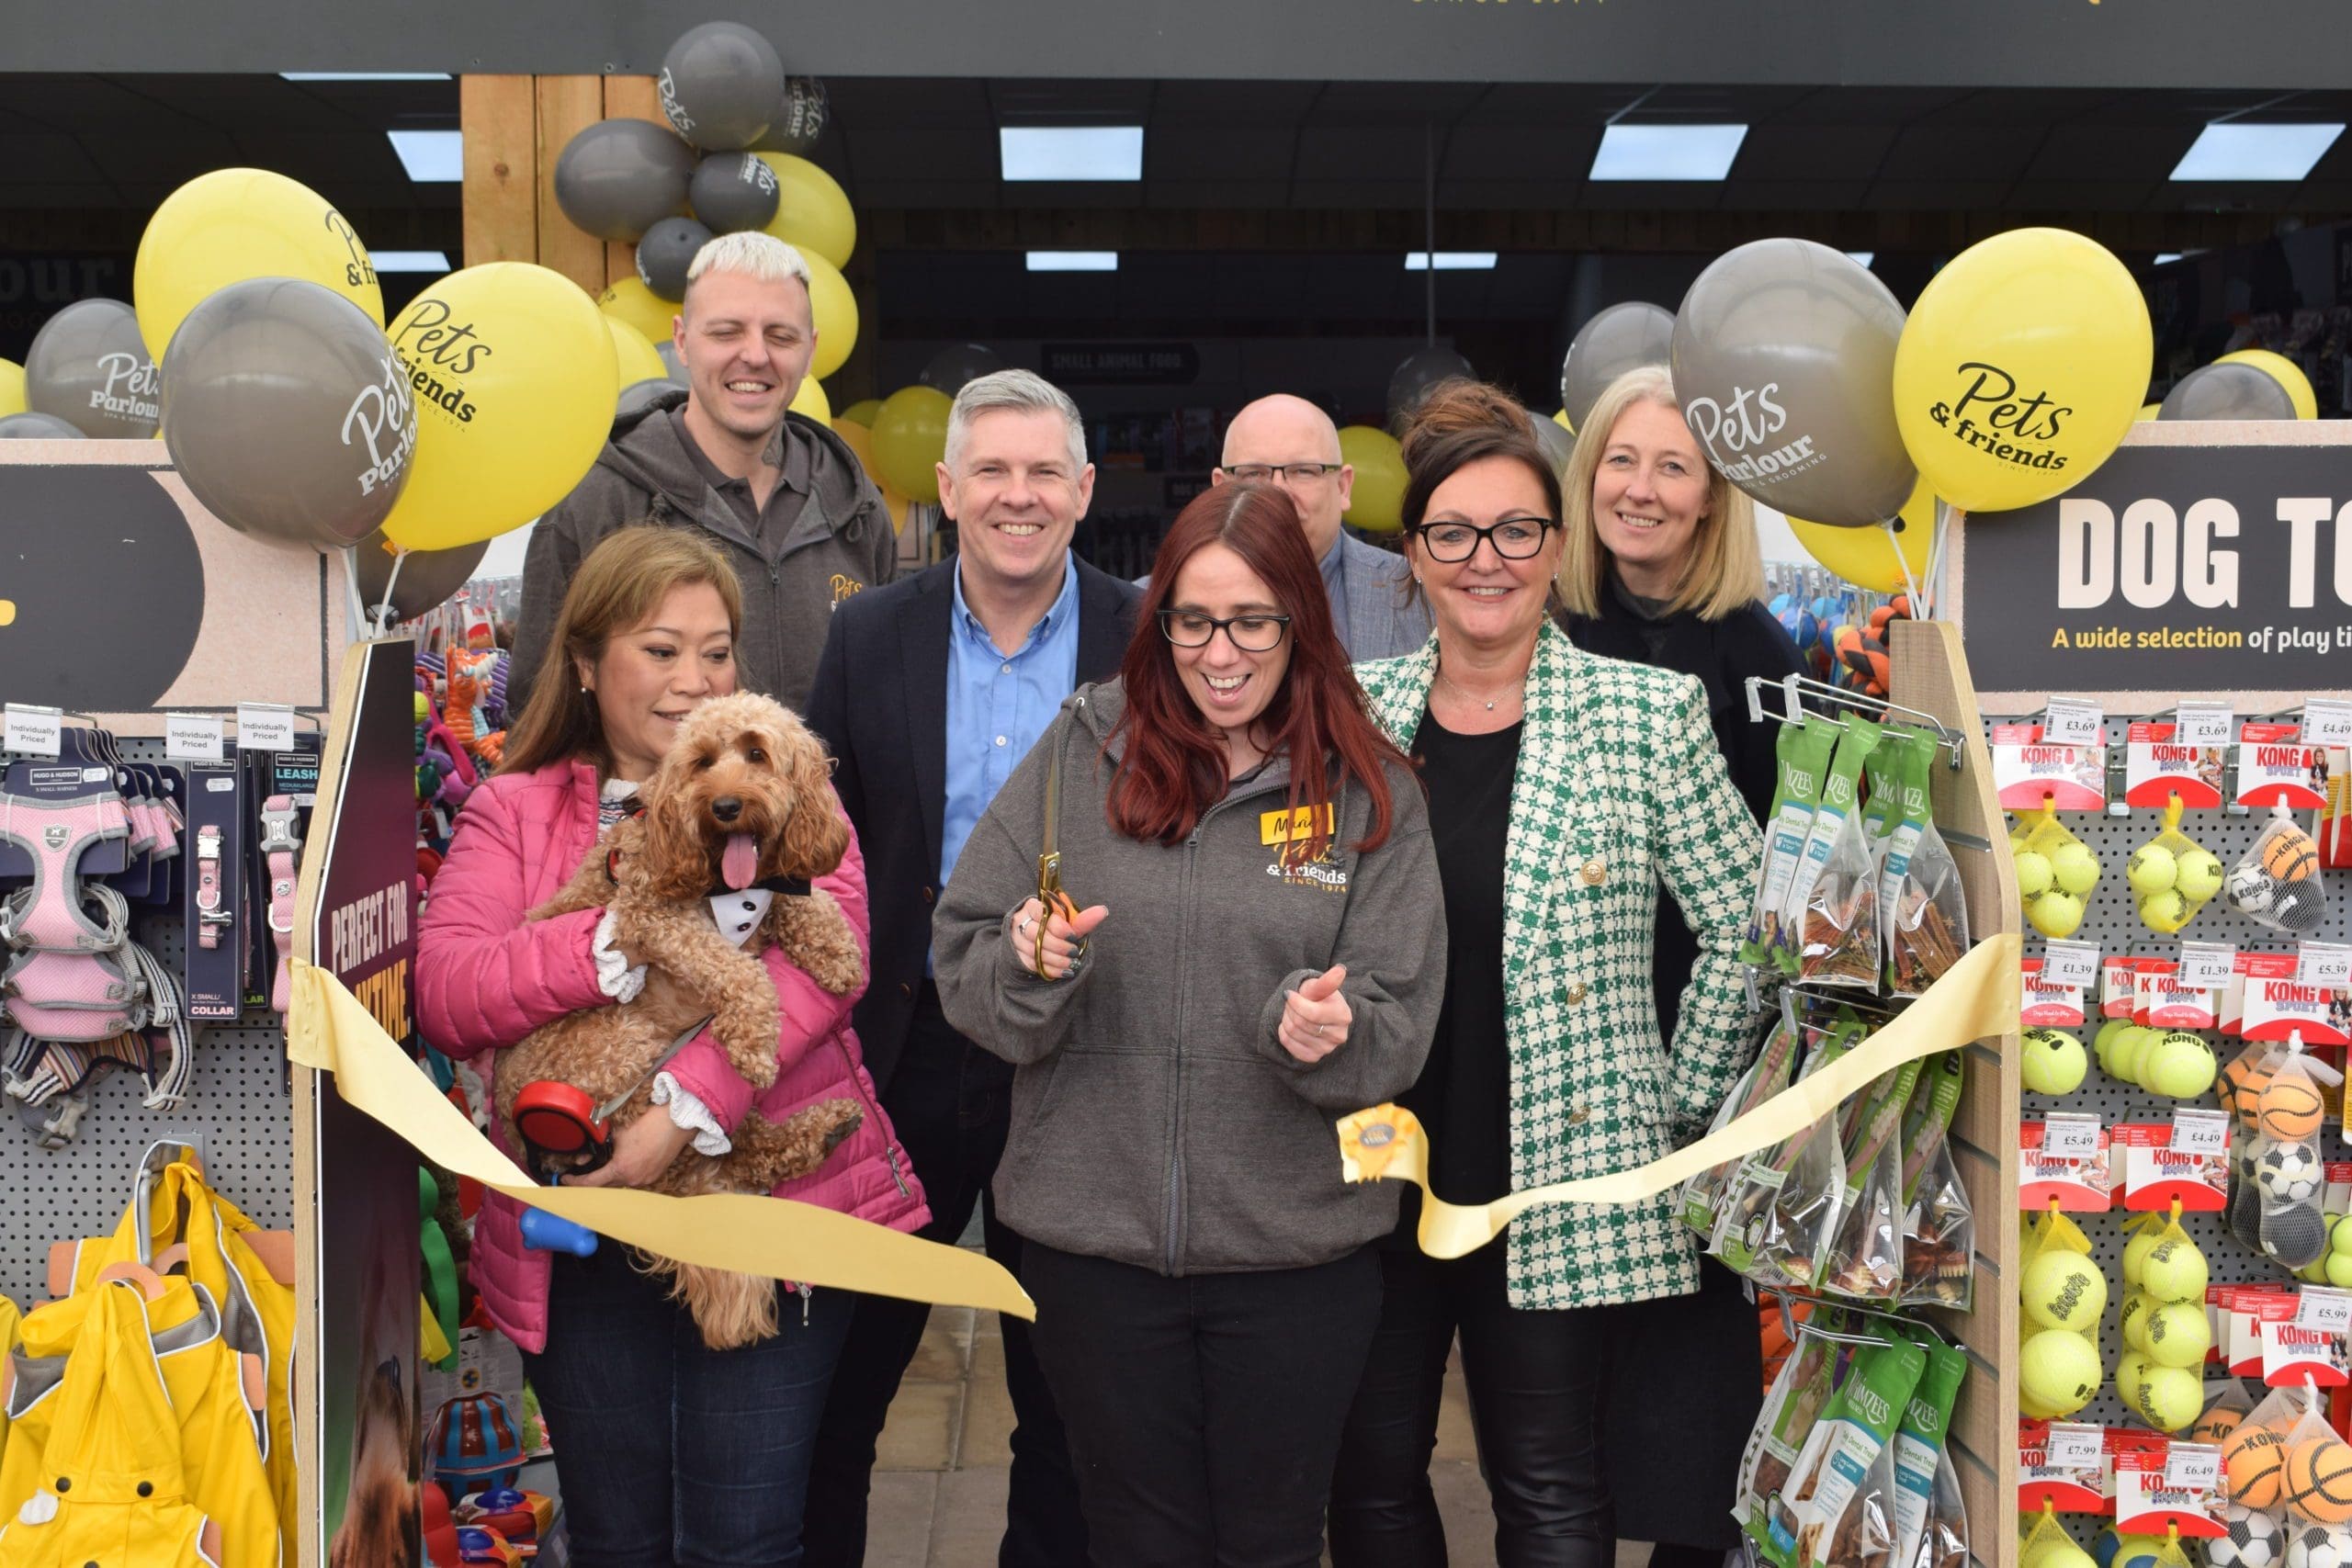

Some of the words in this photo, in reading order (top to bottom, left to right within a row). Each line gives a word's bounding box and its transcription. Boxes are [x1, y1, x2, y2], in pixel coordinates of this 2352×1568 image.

[789, 82, 804, 138] arlour
[394, 299, 492, 374] Pets
[1051, 353, 1093, 368] SMALL
[1098, 353, 1145, 368] ANIMAL
[1149, 353, 1183, 368] FOOD
[96, 352, 159, 397] Pet
[89, 389, 159, 418] Parlou
[1953, 362, 2073, 440] Pets
[1686, 382, 1787, 464] Pets
[1928, 400, 1951, 427] &
[1954, 419, 2069, 469] friends
[358, 412, 418, 495] Parlo
[1713, 434, 1815, 482] Parlour
[1769, 454, 1827, 484] GROOMING
[2057, 497, 2240, 609] DOG
[830, 573, 862, 604] Pets
[2051, 627, 2070, 649] A
[2075, 626, 2131, 649] wide
[2136, 626, 2243, 649] selection
[2247, 626, 2273, 653] of
[2278, 626, 2330, 654] play
[2336, 626, 2352, 648] ti
[10, 724, 56, 737] Individually
[242, 722, 288, 732] Individually
[2065, 720, 2096, 732] £3.69
[2197, 726, 2228, 736] £3.69
[2322, 722, 2352, 734] £4.49
[20, 734, 46, 744] Priced
[172, 730, 218, 740] Individually
[253, 732, 278, 740] Priced
[182, 740, 208, 749] Priced
[2020, 747, 2063, 764] KONG
[2152, 745, 2187, 761] KONG
[2256, 746, 2300, 769] KONG
[276, 768, 318, 780] LEASH
[2266, 765, 2302, 777] SPORT
[1266, 864, 1281, 876] &
[1284, 864, 1347, 885] friends
[2207, 864, 2222, 876] KO
[1284, 876, 1319, 887] SINCE
[1322, 885, 1347, 893] 1974
[332, 890, 384, 977] PERFECT
[387, 880, 408, 950] FOR
[2063, 963, 2092, 975] £1.39
[2199, 965, 2229, 976] £1.39
[2318, 964, 2347, 975] £5.39
[2110, 971, 2135, 986] KO
[243, 995, 265, 1003] LAR
[2264, 981, 2316, 1002] KONG
[355, 958, 412, 1043] YTIME.
[2275, 999, 2319, 1013] SPORT
[191, 1006, 234, 1015] COLLAR
[2162, 1034, 2201, 1046] KONG
[2064, 1135, 2093, 1145] £5.49
[2191, 1132, 2221, 1143] £4.49
[2153, 1149, 2191, 1166] KONG
[2317, 1308, 2347, 1319] £5.99
[2277, 1325, 2319, 1346] KONG
[2287, 1344, 2324, 1355] SPORT
[1906, 1397, 1939, 1433] ZEES
[2211, 1422, 2233, 1439] KO
[2066, 1446, 2097, 1455] £7.99
[2020, 1451, 2047, 1467] KON
[2184, 1465, 2213, 1475] £6.49
[2140, 1473, 2188, 1493] KO
